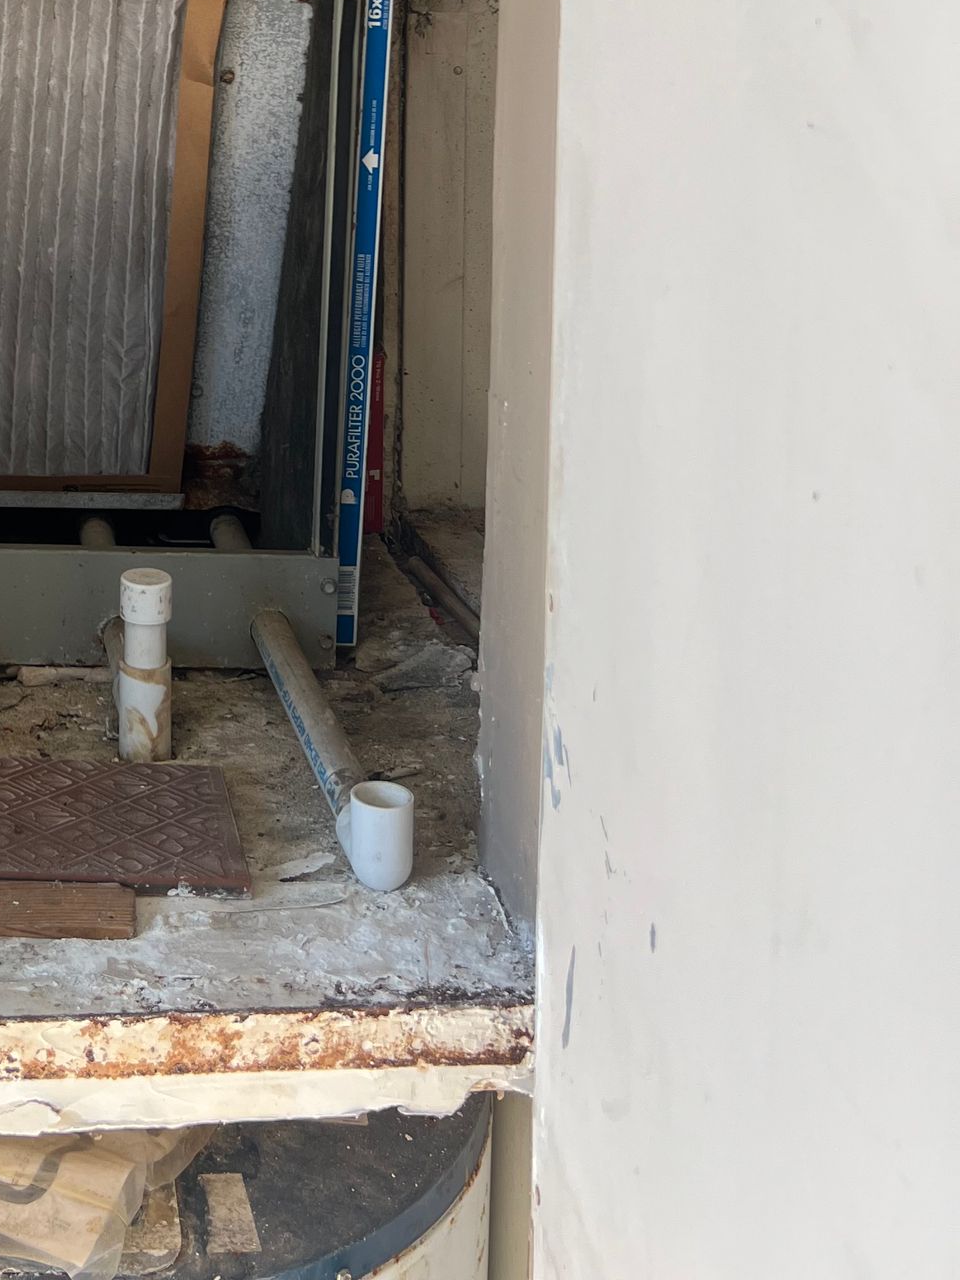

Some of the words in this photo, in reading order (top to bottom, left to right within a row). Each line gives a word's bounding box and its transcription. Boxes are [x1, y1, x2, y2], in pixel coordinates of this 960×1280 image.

[356, 272, 364, 282] AIR
[354, 283, 363, 320] PERFORMANCE
[352, 321, 362, 348] ALLERGEN
[350, 354, 366, 400] 2000
[346, 405, 362, 478] PURAFILTER
